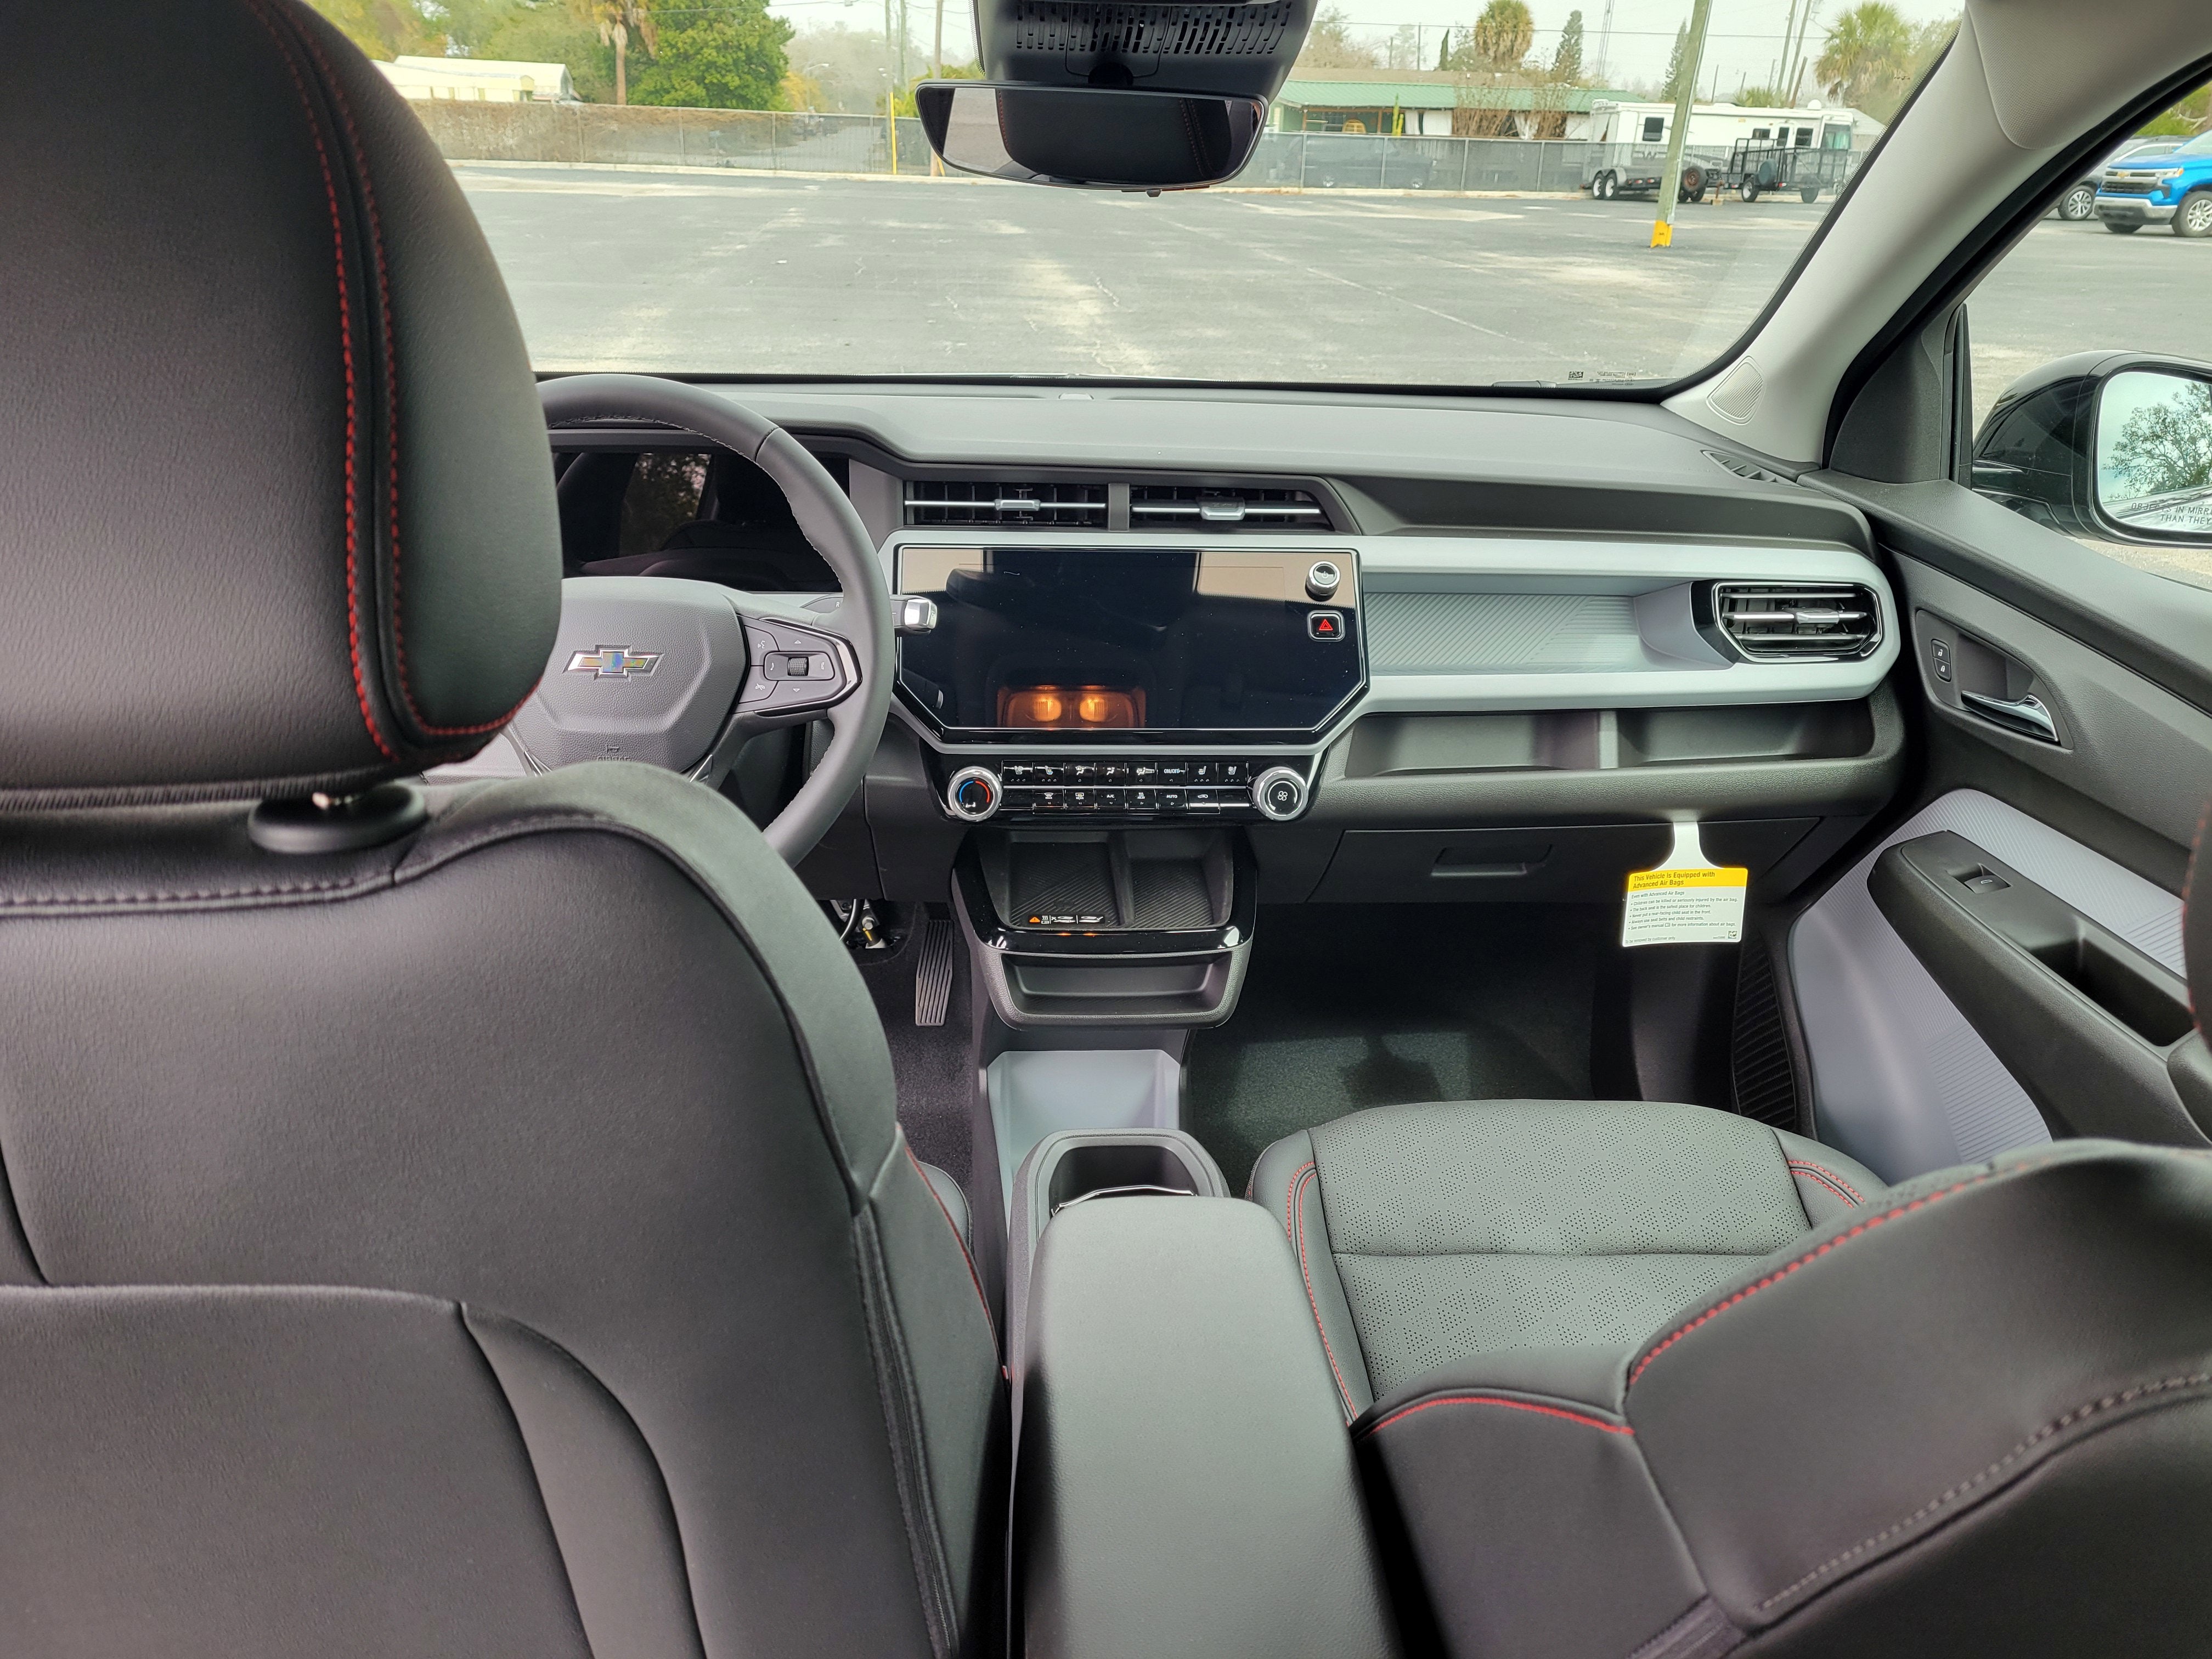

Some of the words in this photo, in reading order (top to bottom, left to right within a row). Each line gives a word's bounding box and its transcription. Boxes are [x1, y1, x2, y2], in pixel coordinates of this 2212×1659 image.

[2161, 514, 2185, 523] THAN
[2189, 516, 2212, 524] THEY
[1633, 881, 1658, 889] Advanced
